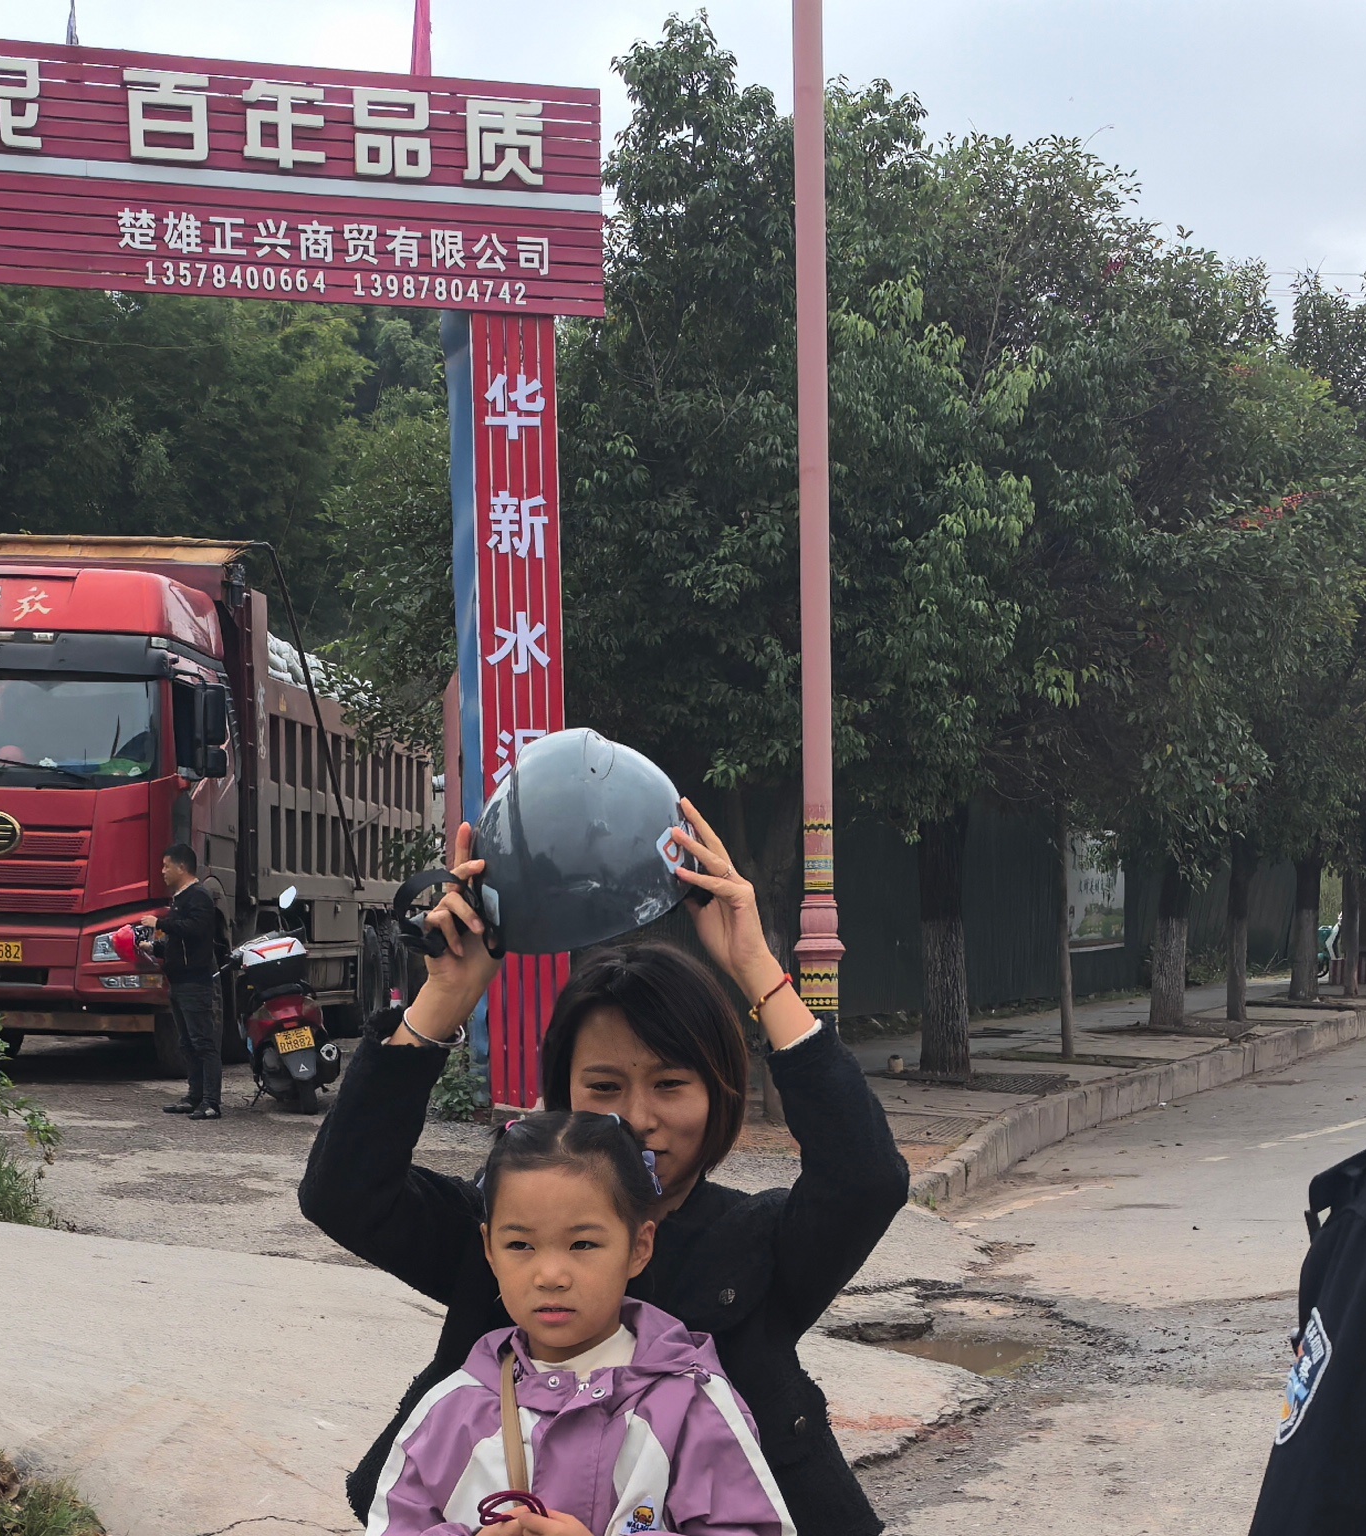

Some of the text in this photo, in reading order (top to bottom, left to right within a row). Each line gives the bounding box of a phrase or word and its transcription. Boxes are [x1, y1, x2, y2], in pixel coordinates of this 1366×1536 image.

[122, 68, 544, 186] 百年品质
[117, 207, 550, 276] 楚雄正兴商贸有限公司
[144, 260, 527, 306] 13578400664 13987804742
